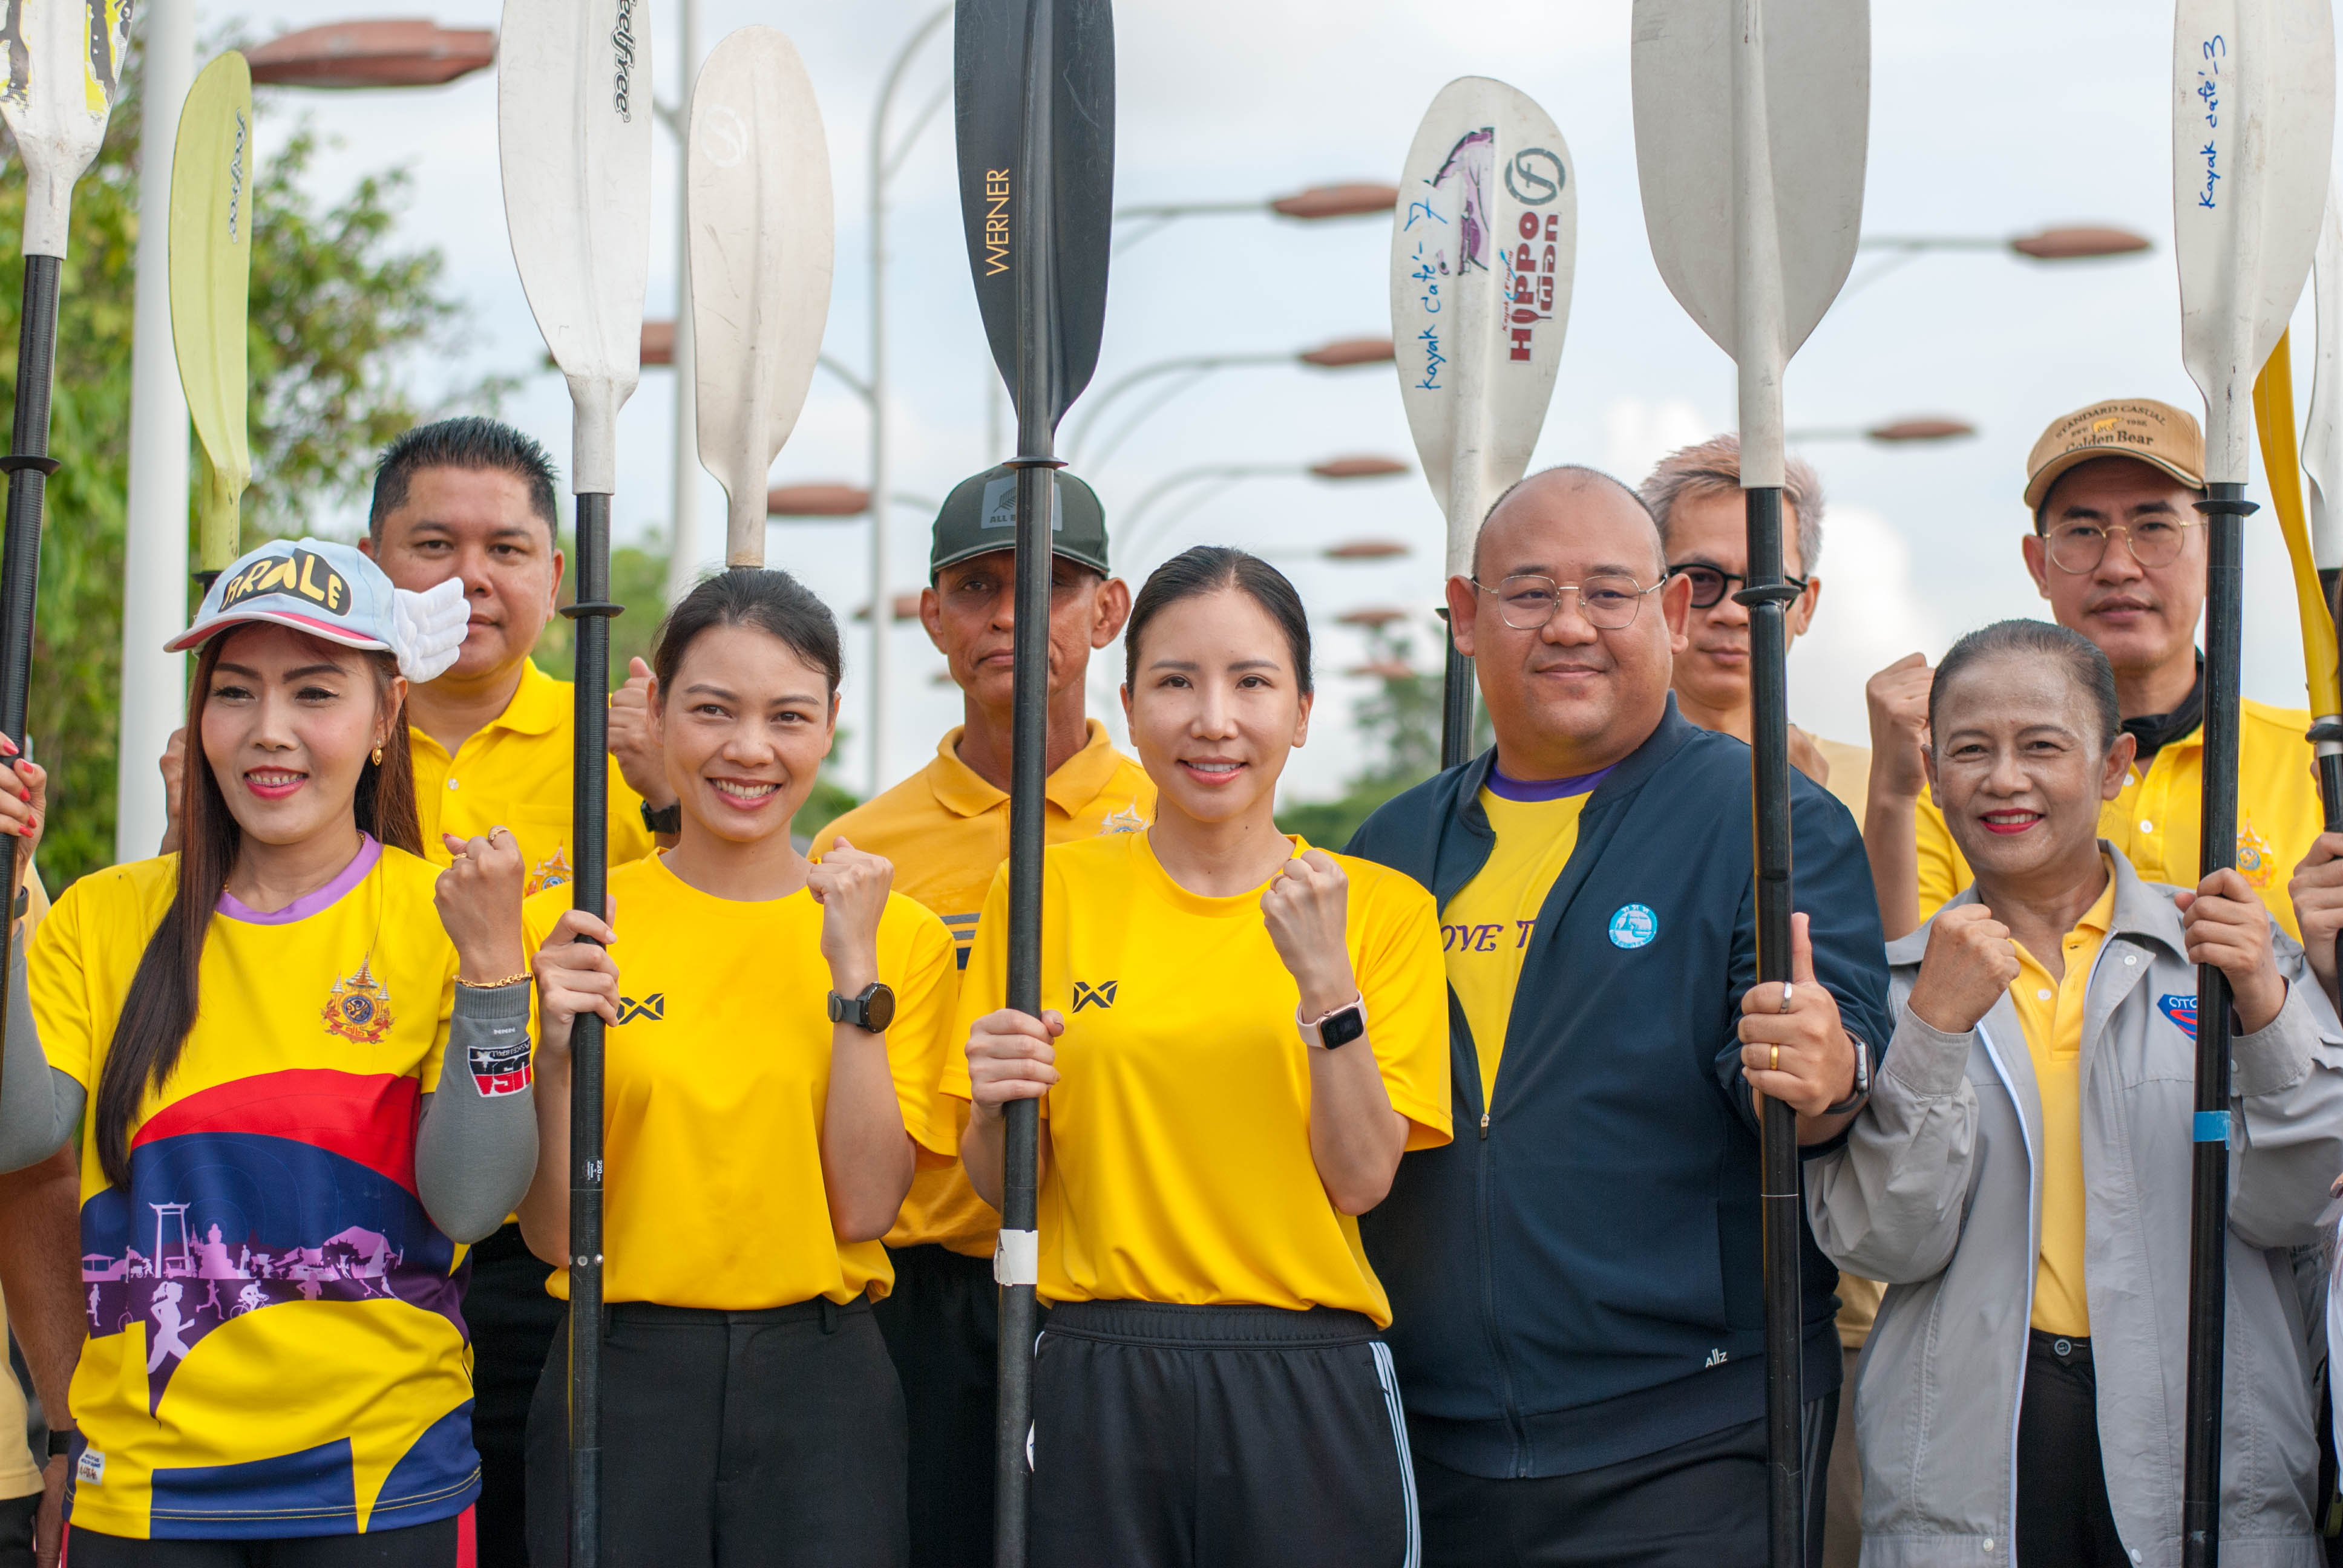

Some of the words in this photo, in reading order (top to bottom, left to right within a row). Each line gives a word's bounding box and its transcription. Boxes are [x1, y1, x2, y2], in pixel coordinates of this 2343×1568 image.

[611, 0, 636, 115] eelfree
[985, 168, 1010, 276] WERNER
[2056, 406, 2119, 439] STANDARD
[2121, 405, 2166, 426] CASUAL
[2117, 430, 2154, 446] Bear
[989, 515, 1008, 523] ALL
